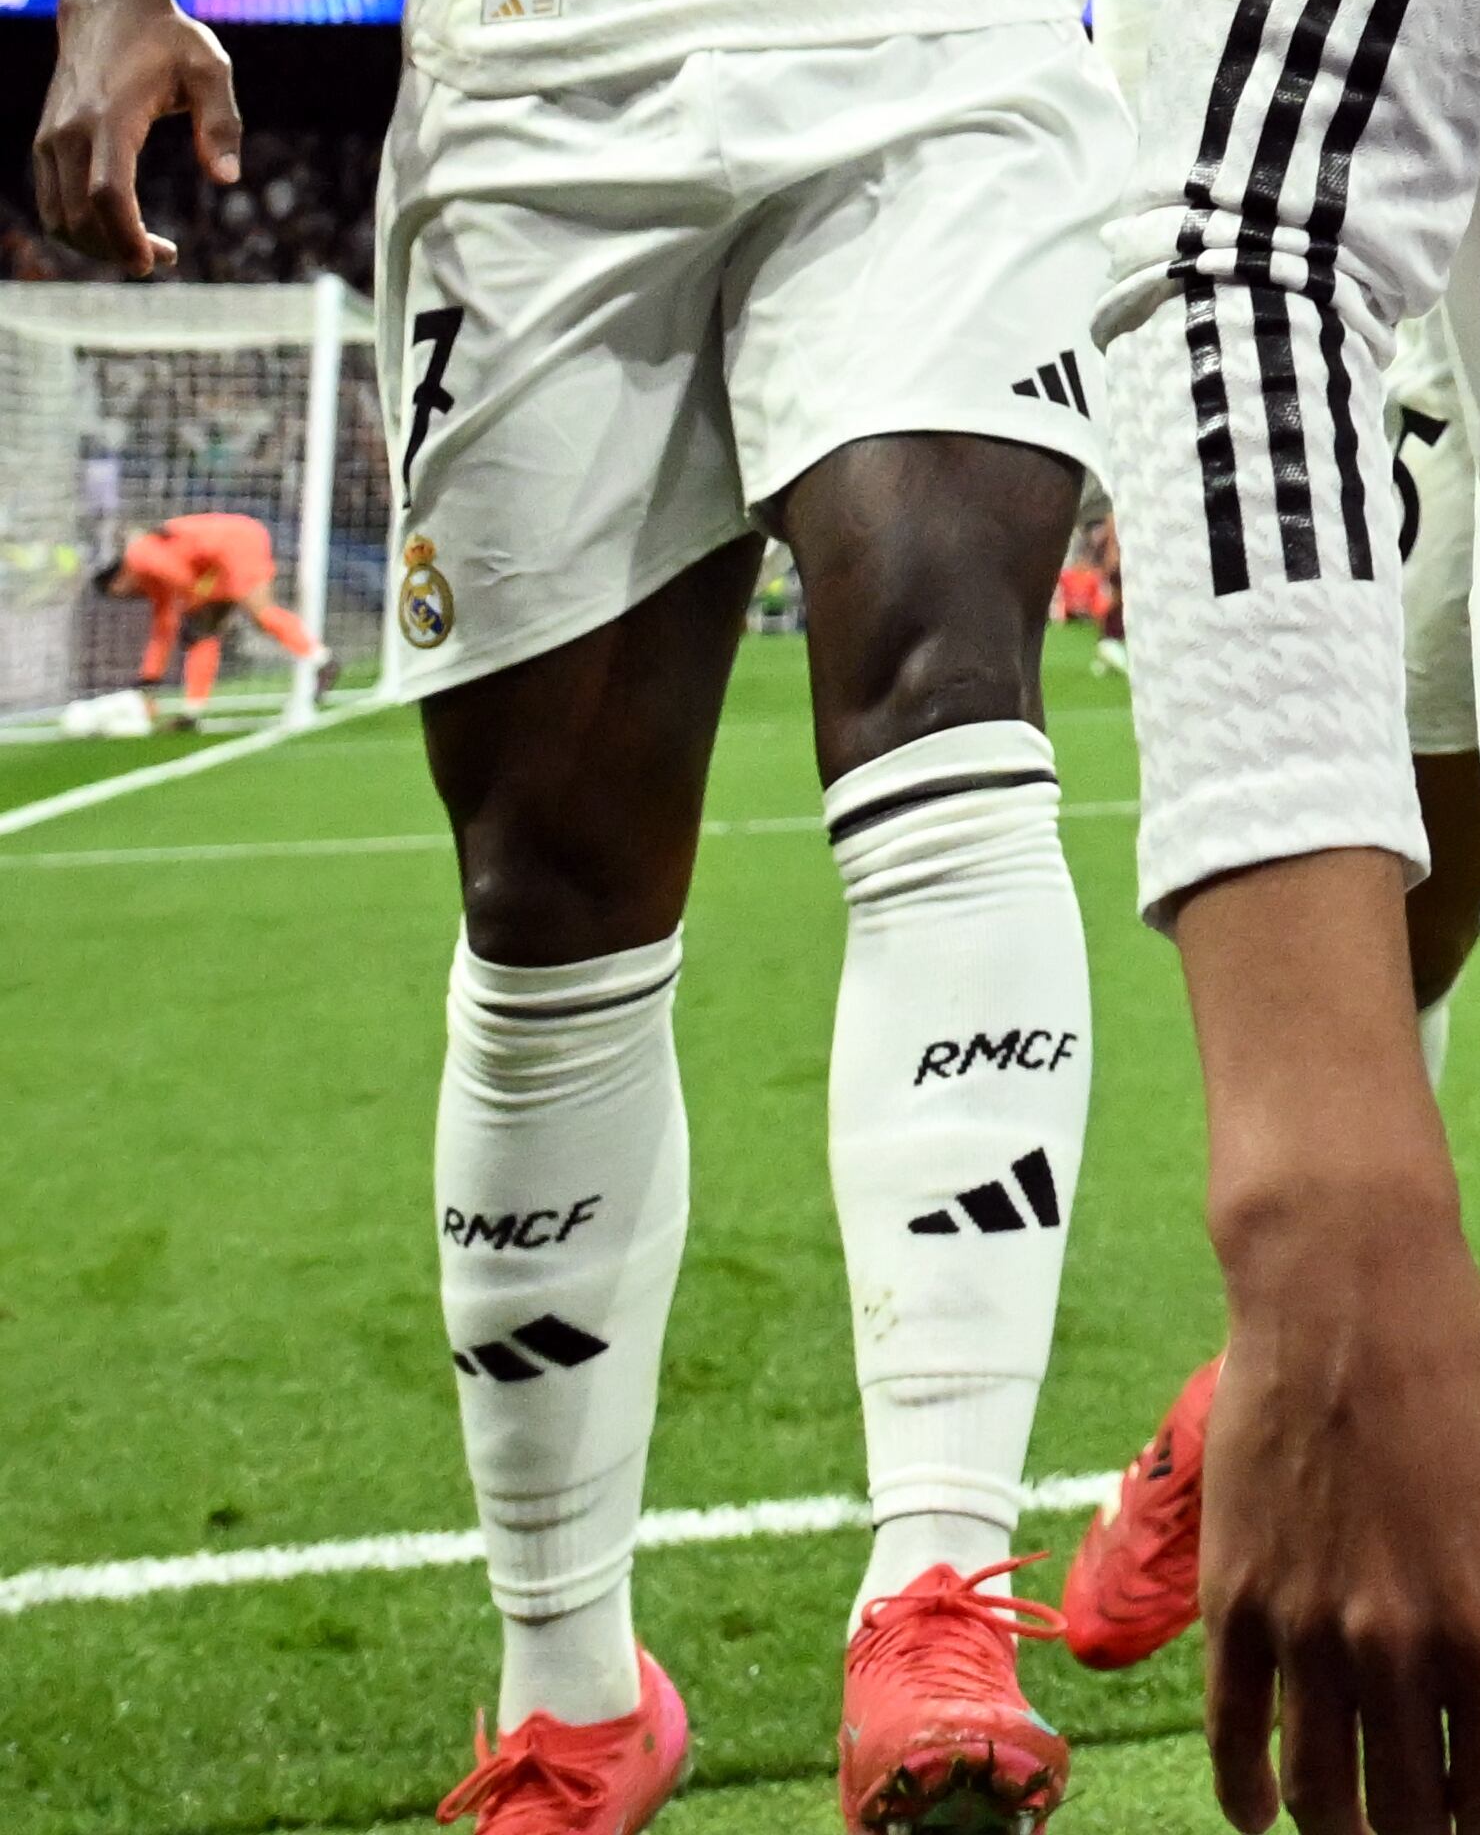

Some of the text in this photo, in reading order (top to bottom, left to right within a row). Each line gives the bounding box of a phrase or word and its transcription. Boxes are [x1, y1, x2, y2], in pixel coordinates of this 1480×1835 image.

[402, 305, 464, 510] 7
[913, 1027, 1079, 1087] RMCF
[443, 1194, 602, 1252] RMCF
